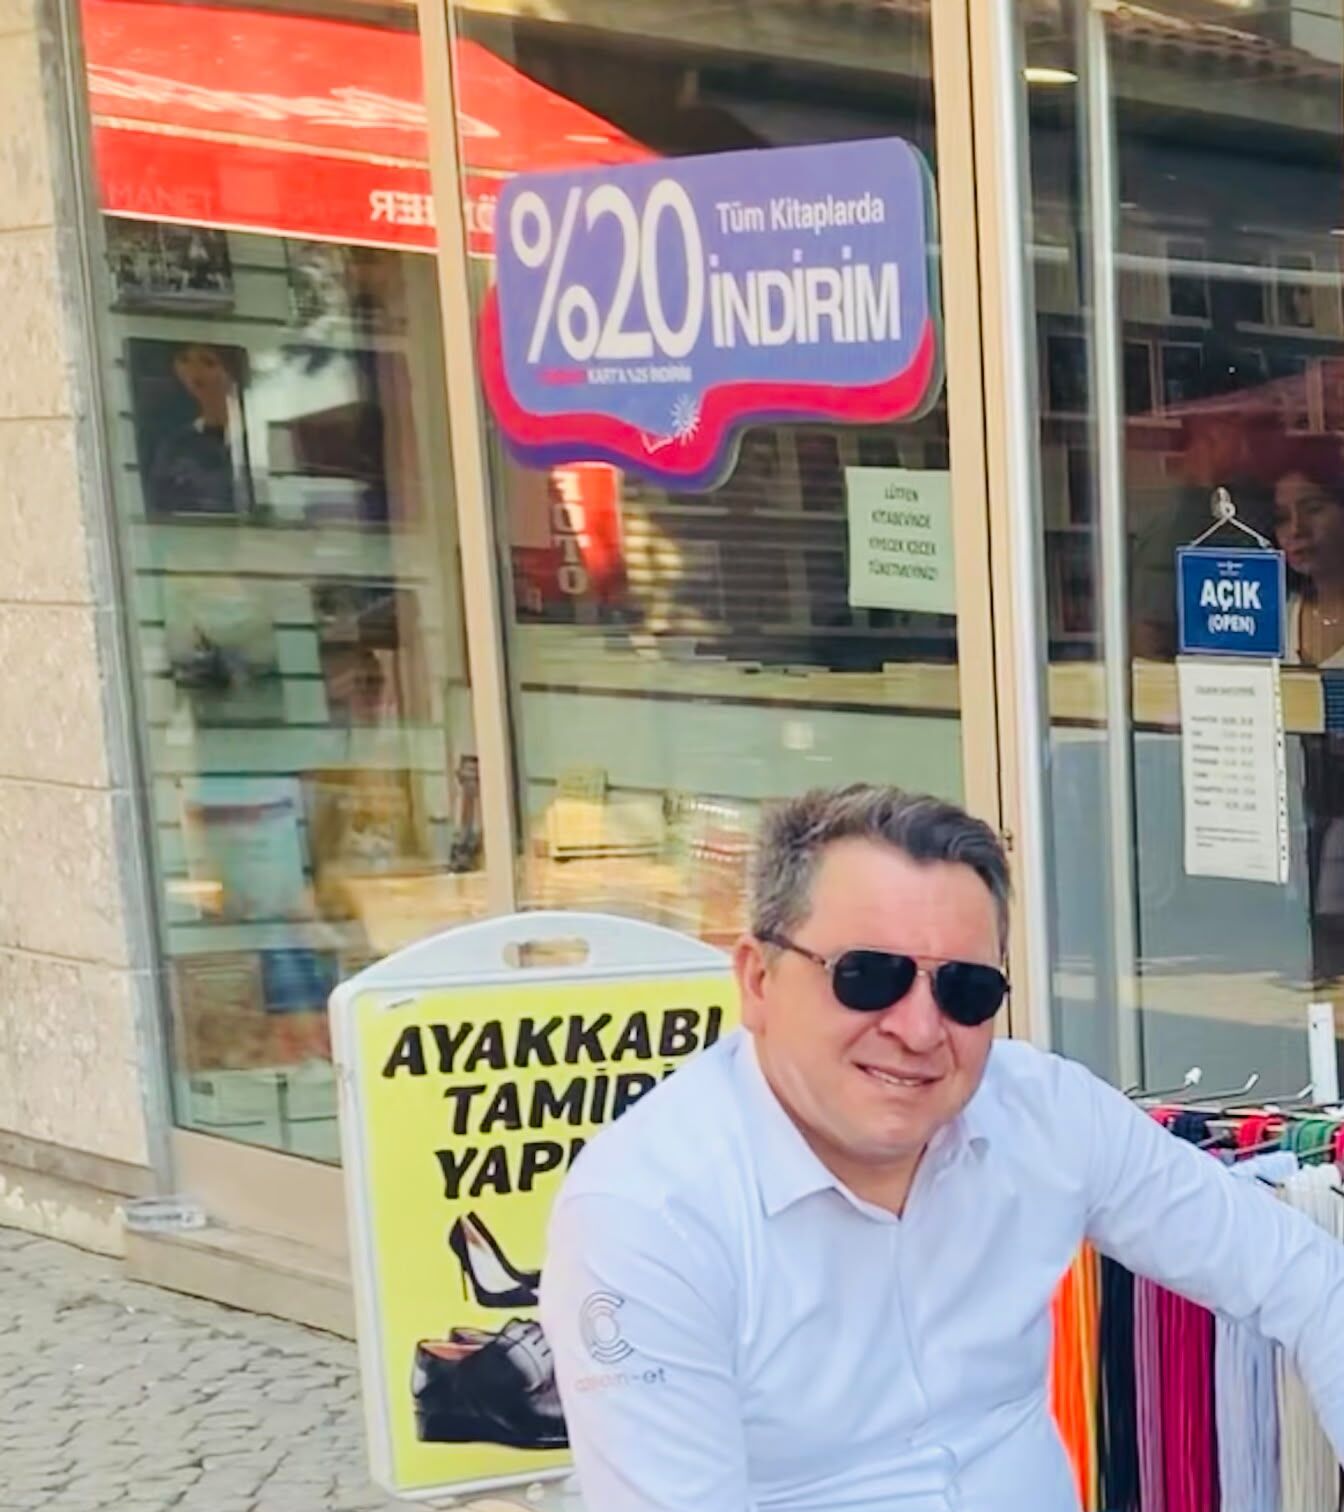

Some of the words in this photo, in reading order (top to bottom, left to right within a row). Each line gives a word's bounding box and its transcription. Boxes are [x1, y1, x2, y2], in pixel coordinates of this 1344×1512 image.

[716, 202, 765, 233] Tüm
[771, 193, 885, 237] Kitaplarda
[510, 178, 704, 363] %20
[709, 246, 901, 348] İNDİRİM
[1200, 579, 1262, 612] AÇIK
[1207, 613, 1256, 636] (OPEN)
[382, 1006, 723, 1079] AYAKKABI
[443, 1063, 677, 1136] TAMİR
